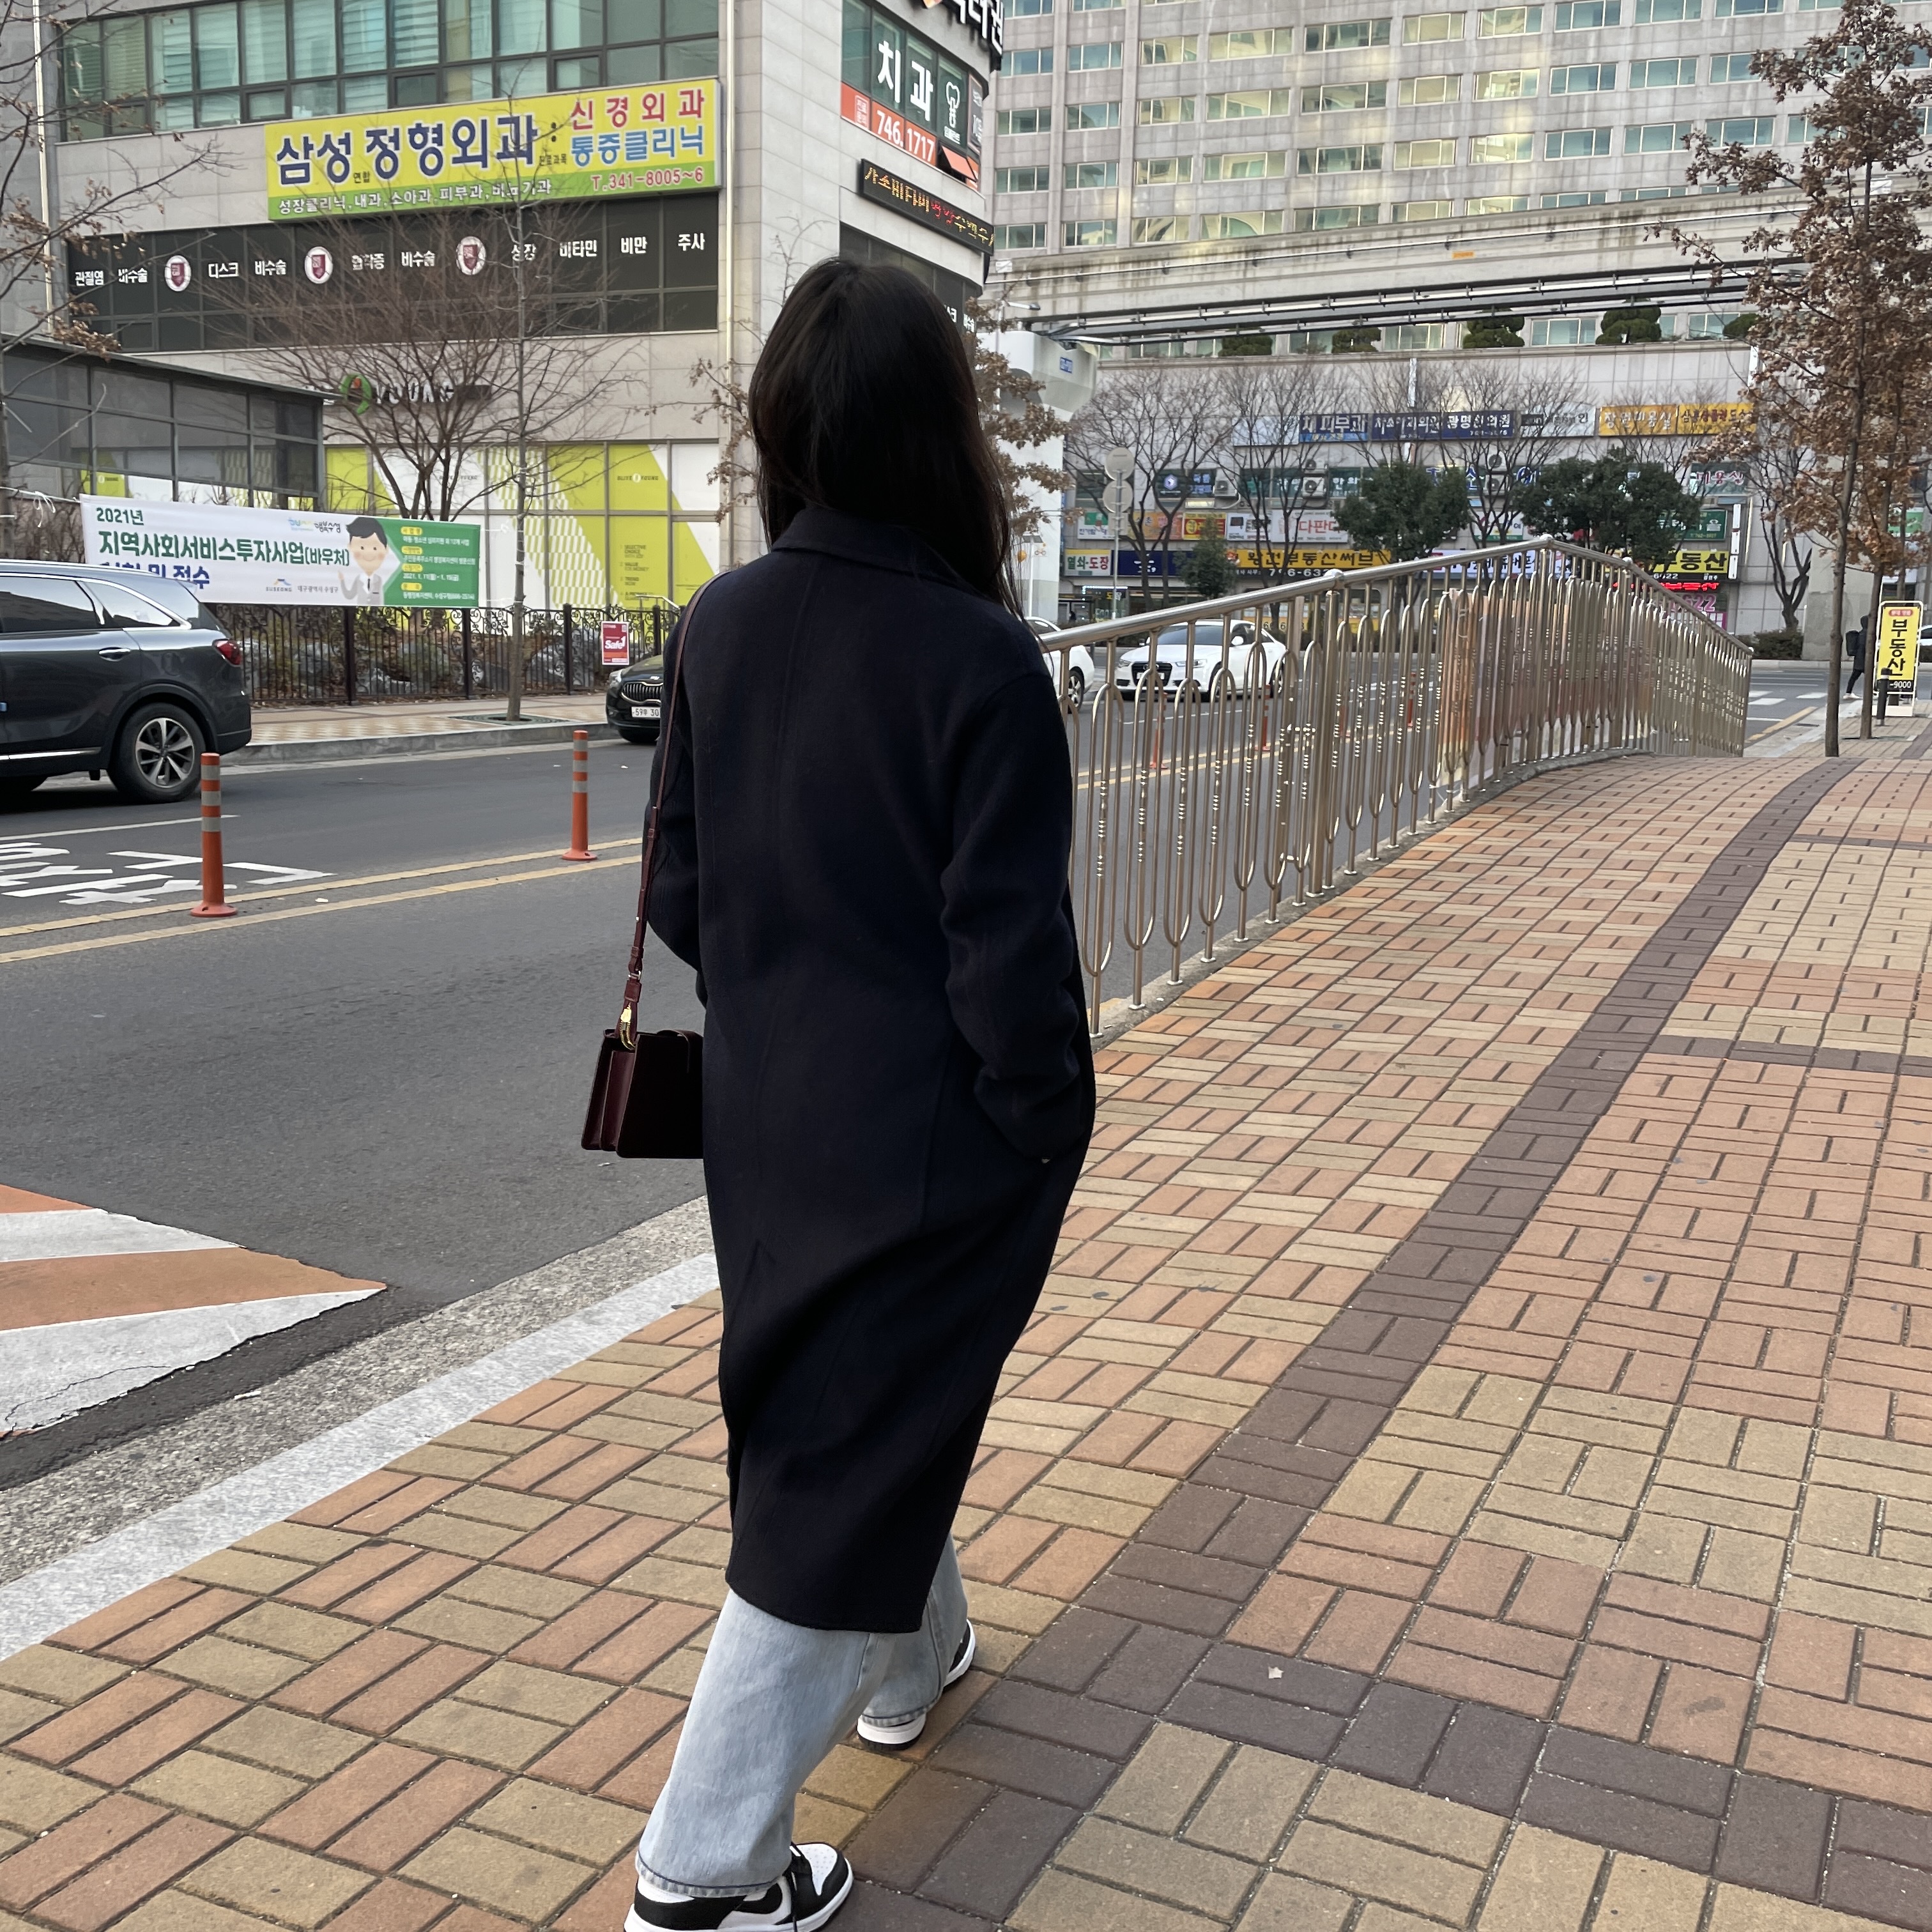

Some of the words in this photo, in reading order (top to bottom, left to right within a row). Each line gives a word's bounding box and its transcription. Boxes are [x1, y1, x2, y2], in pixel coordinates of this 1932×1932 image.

[878, 40, 933, 121] 치과
[571, 89, 705, 130] 신경외과
[876, 109, 935, 162] 746.1717
[277, 132, 351, 185] 삼성
[366, 114, 538, 180] 정형외과
[571, 125, 703, 167] 통증클리닉
[75, 270, 104, 287] 관절염
[118, 267, 148, 284] 비수술
[208, 263, 239, 279] 디스크
[255, 259, 287, 277] 비수술
[401, 250, 436, 267] 비수술
[560, 240, 597, 258] 비타민
[621, 236, 647, 254] 비만
[678, 233, 705, 251] 주사
[96, 507, 144, 526] 2021년
[98, 530, 349, 567] 지역사회서비스투자사업(바우처)
[1887, 619, 1908, 676] 부동산
